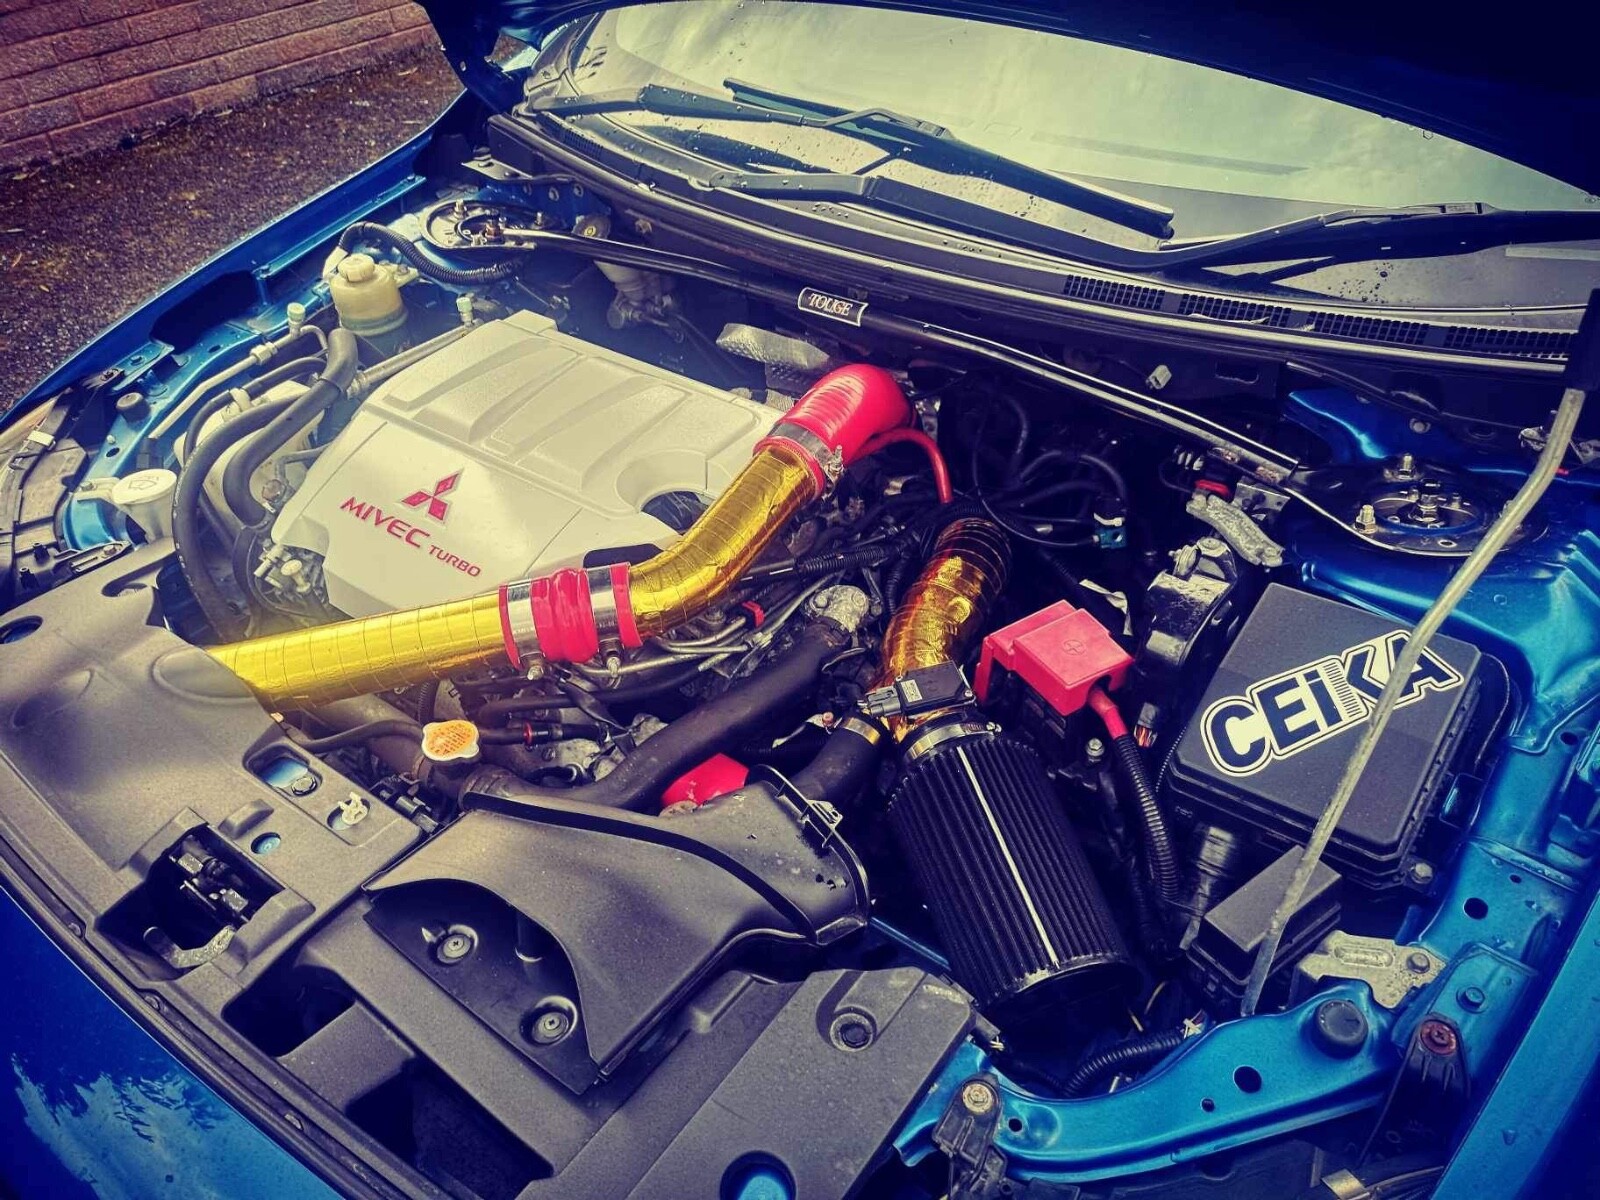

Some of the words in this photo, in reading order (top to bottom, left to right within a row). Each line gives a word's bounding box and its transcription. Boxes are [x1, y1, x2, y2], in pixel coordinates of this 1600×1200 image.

[808, 292, 853, 316] TOUGE
[340, 496, 431, 549] MIVEC
[429, 544, 482, 578] TURBO
